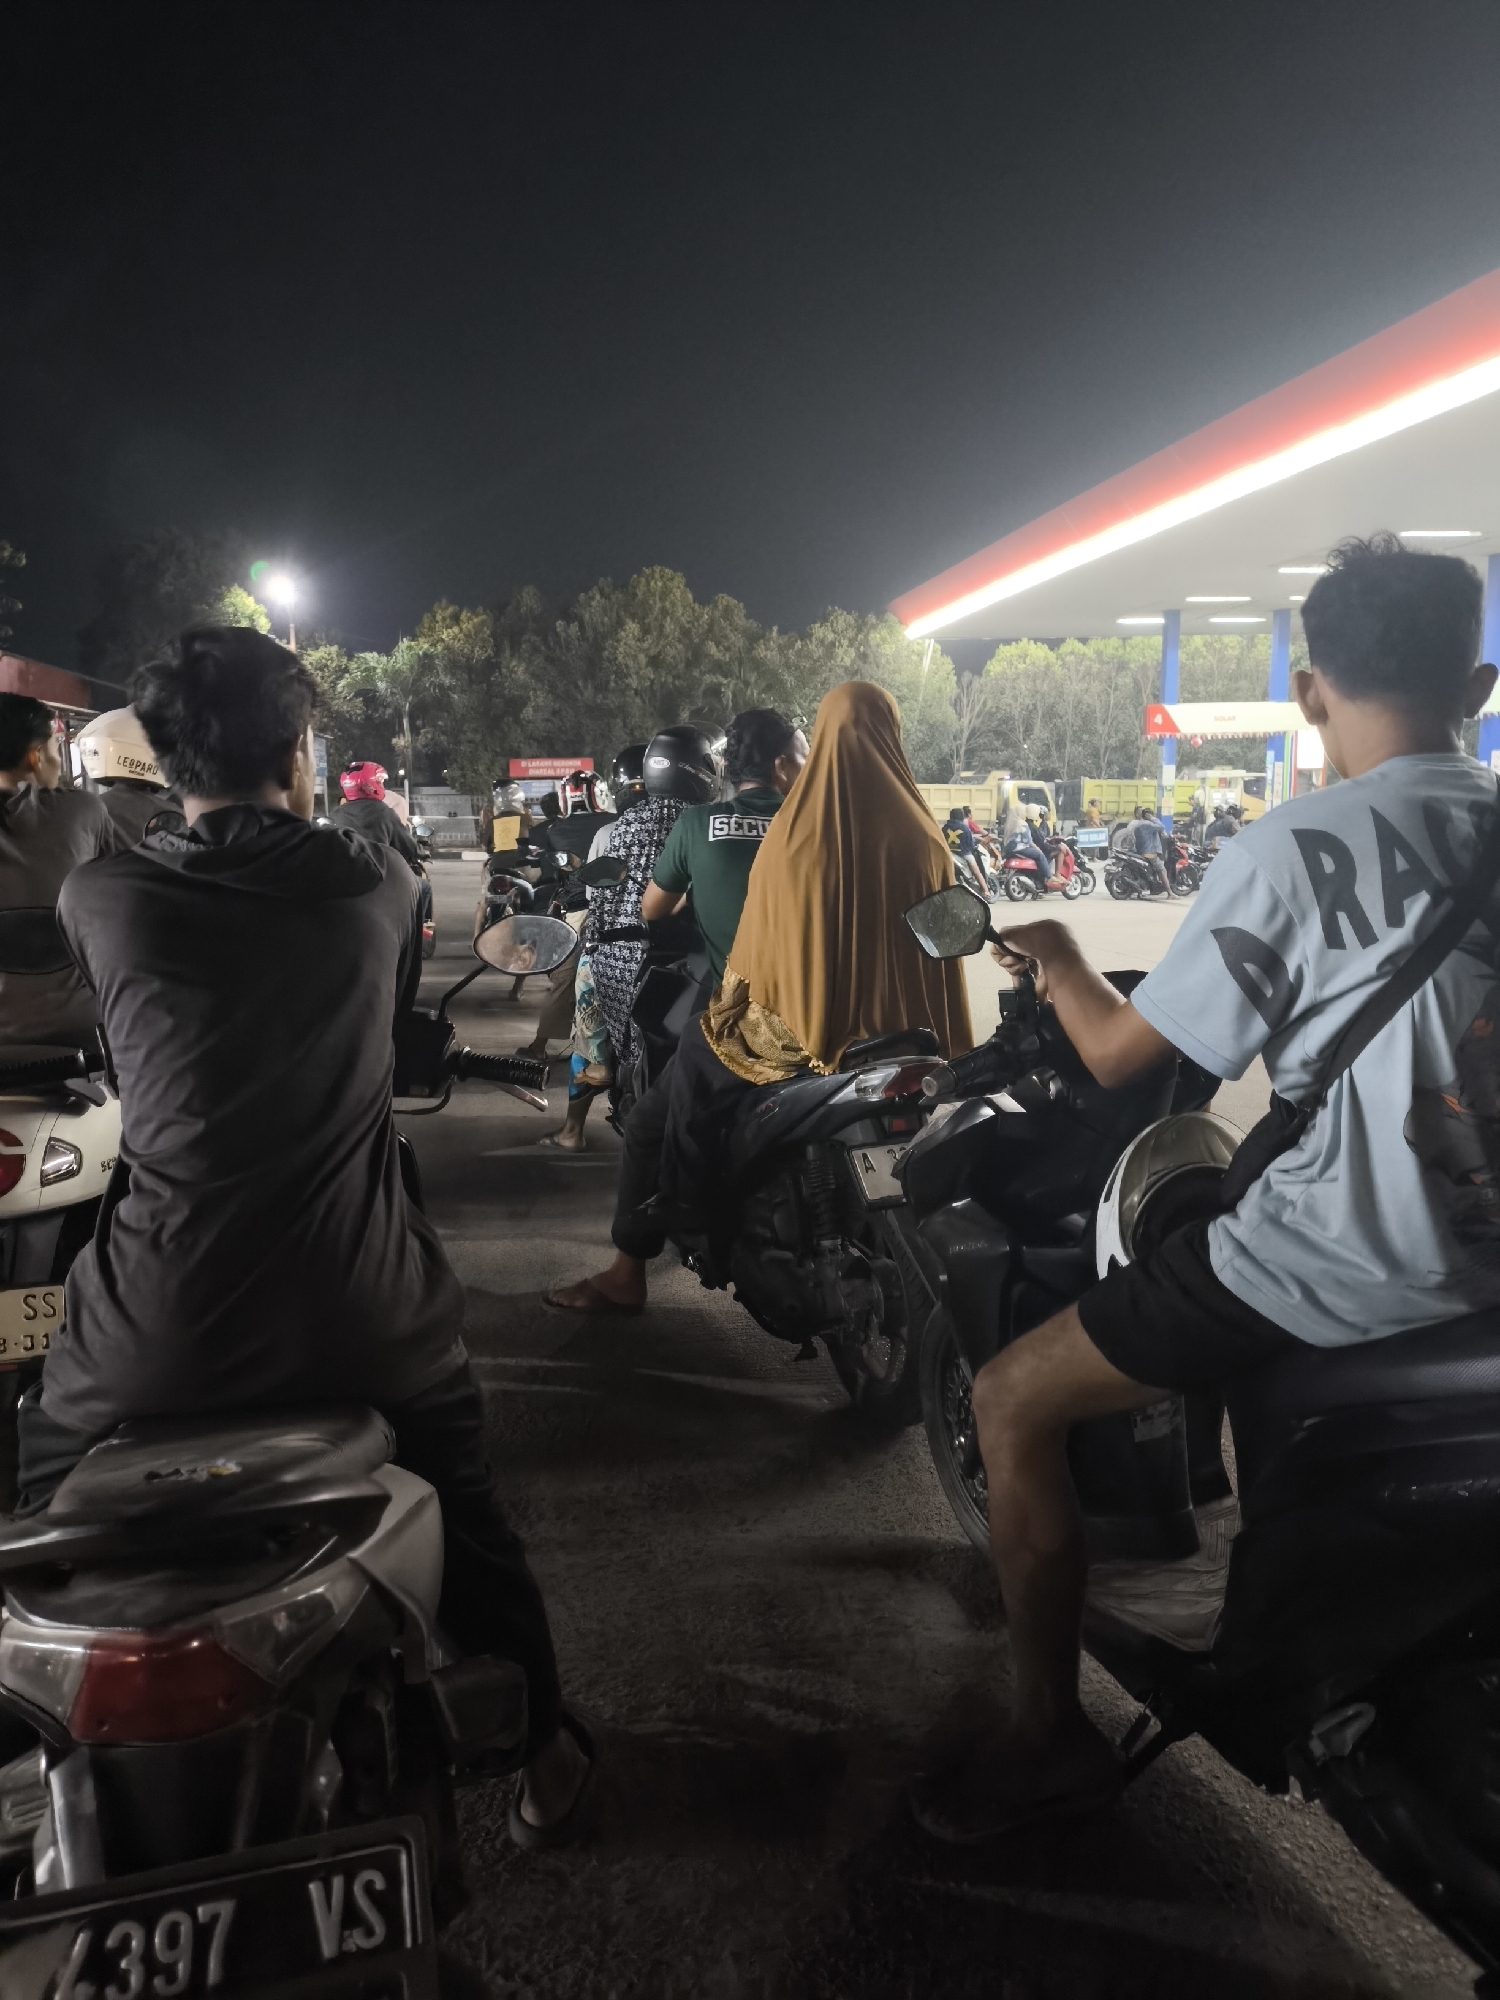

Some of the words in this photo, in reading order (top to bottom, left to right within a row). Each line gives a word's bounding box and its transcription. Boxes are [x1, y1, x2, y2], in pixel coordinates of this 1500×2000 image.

[1153, 713, 1163, 725] 4
[116, 755, 159, 776] LEOPARD
[862, 1152, 877, 1174] A
[22, 1292, 57, 1320] SS
[308, 1868, 388, 1962] VS
